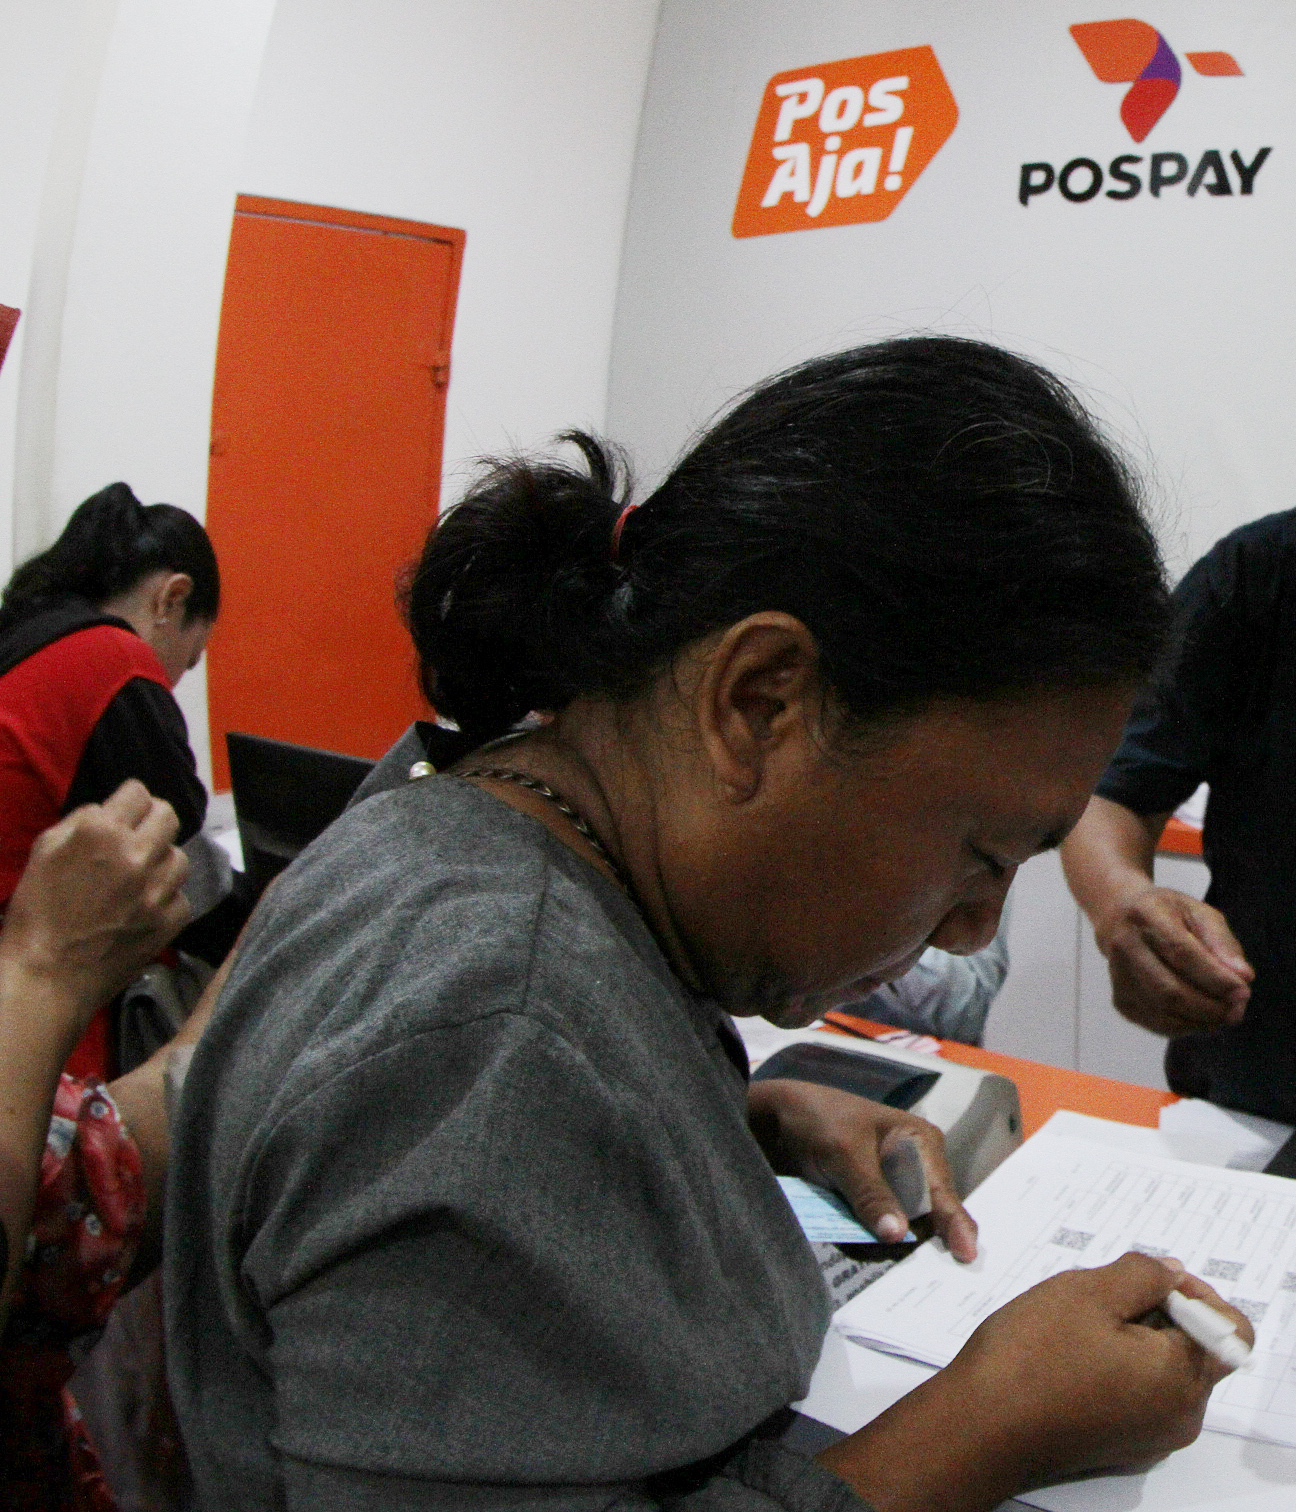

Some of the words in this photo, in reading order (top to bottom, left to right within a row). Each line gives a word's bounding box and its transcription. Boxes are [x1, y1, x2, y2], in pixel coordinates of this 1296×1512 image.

[773, 75, 910, 142] Pos
[760, 125, 914, 218] Aja!
[1018, 147, 1273, 207] POSPAY
